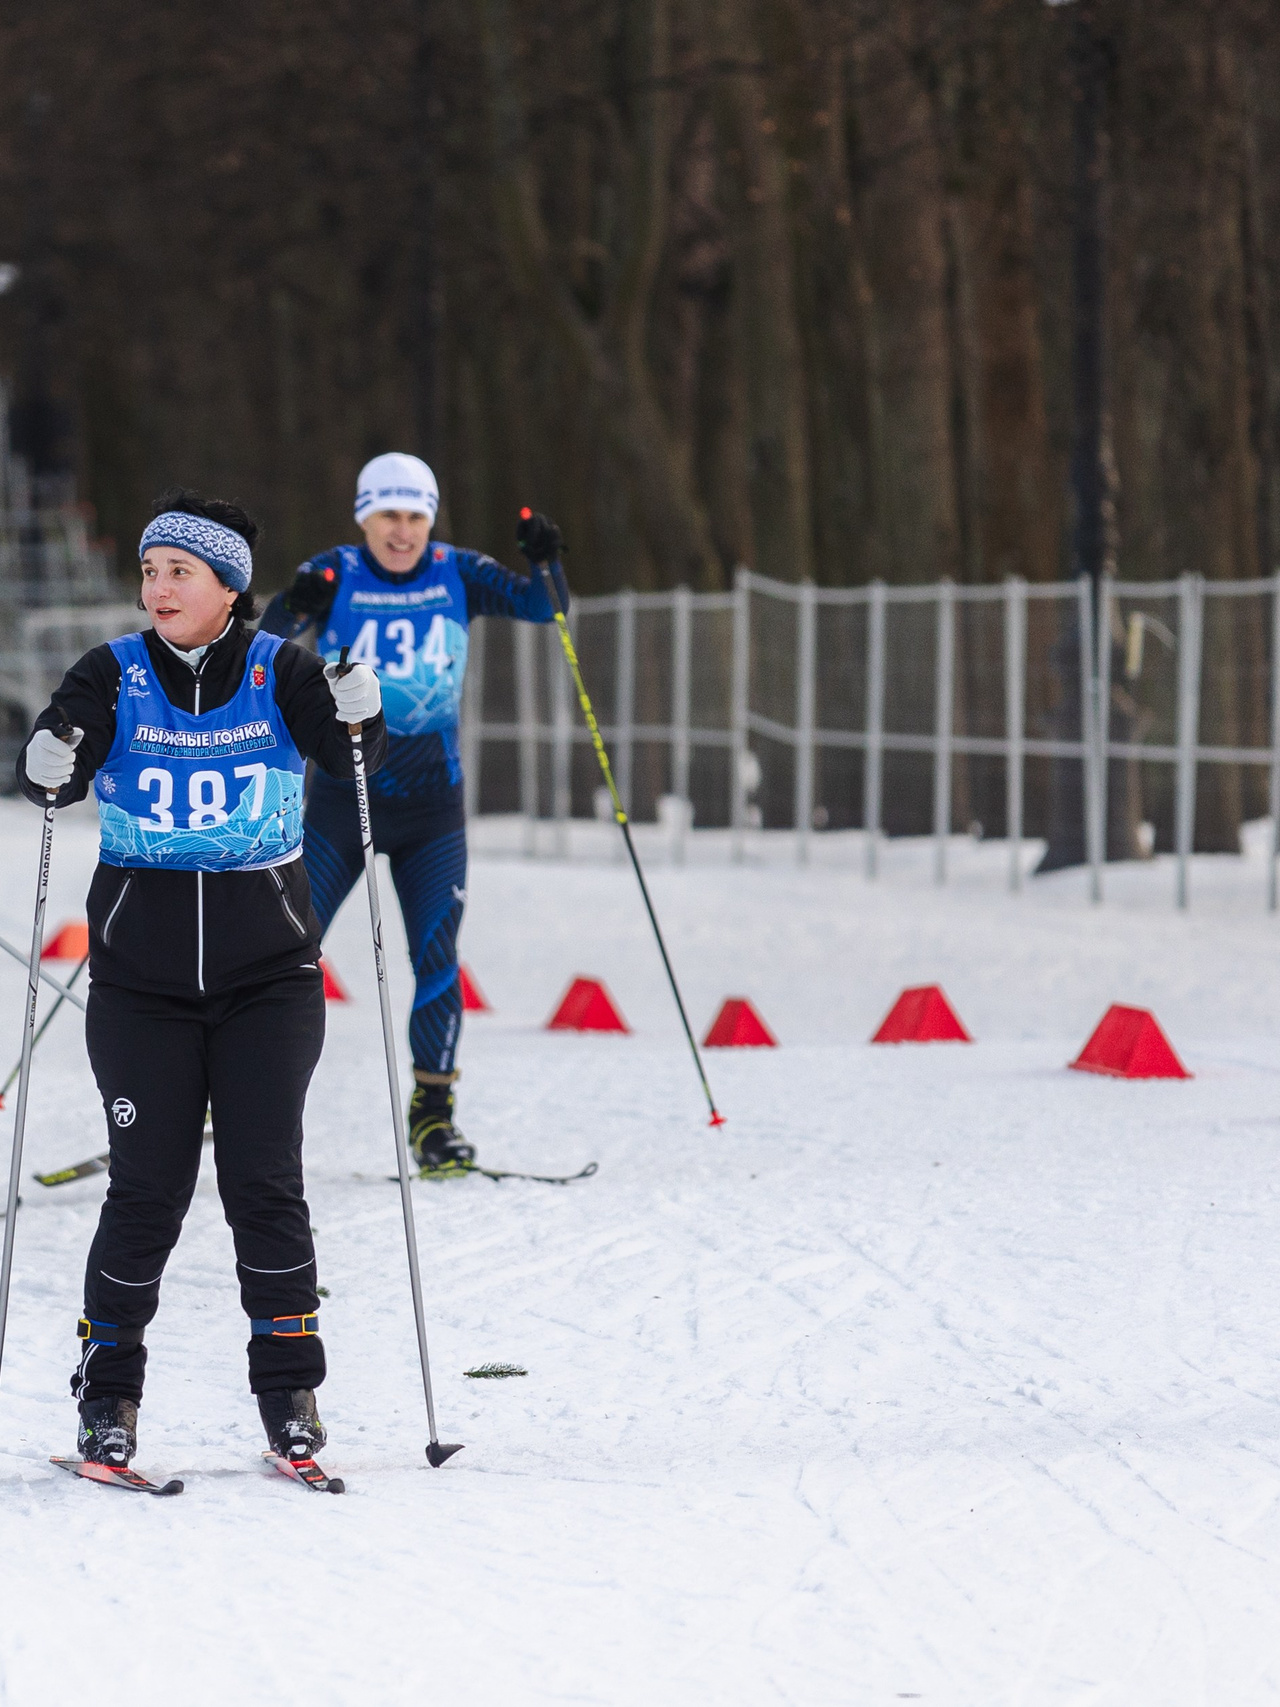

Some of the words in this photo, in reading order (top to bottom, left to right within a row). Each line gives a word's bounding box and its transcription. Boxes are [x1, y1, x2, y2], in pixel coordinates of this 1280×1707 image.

[350, 614, 451, 678] 434
[136, 726, 210, 747] ЛЫЖНЫЕ
[215, 722, 270, 745] ГОНКИ
[143, 741, 165, 753] КУБОК
[138, 763, 267, 832] 387
[355, 772, 369, 834] NORDWAY
[41, 827, 53, 887] NORDWAY
